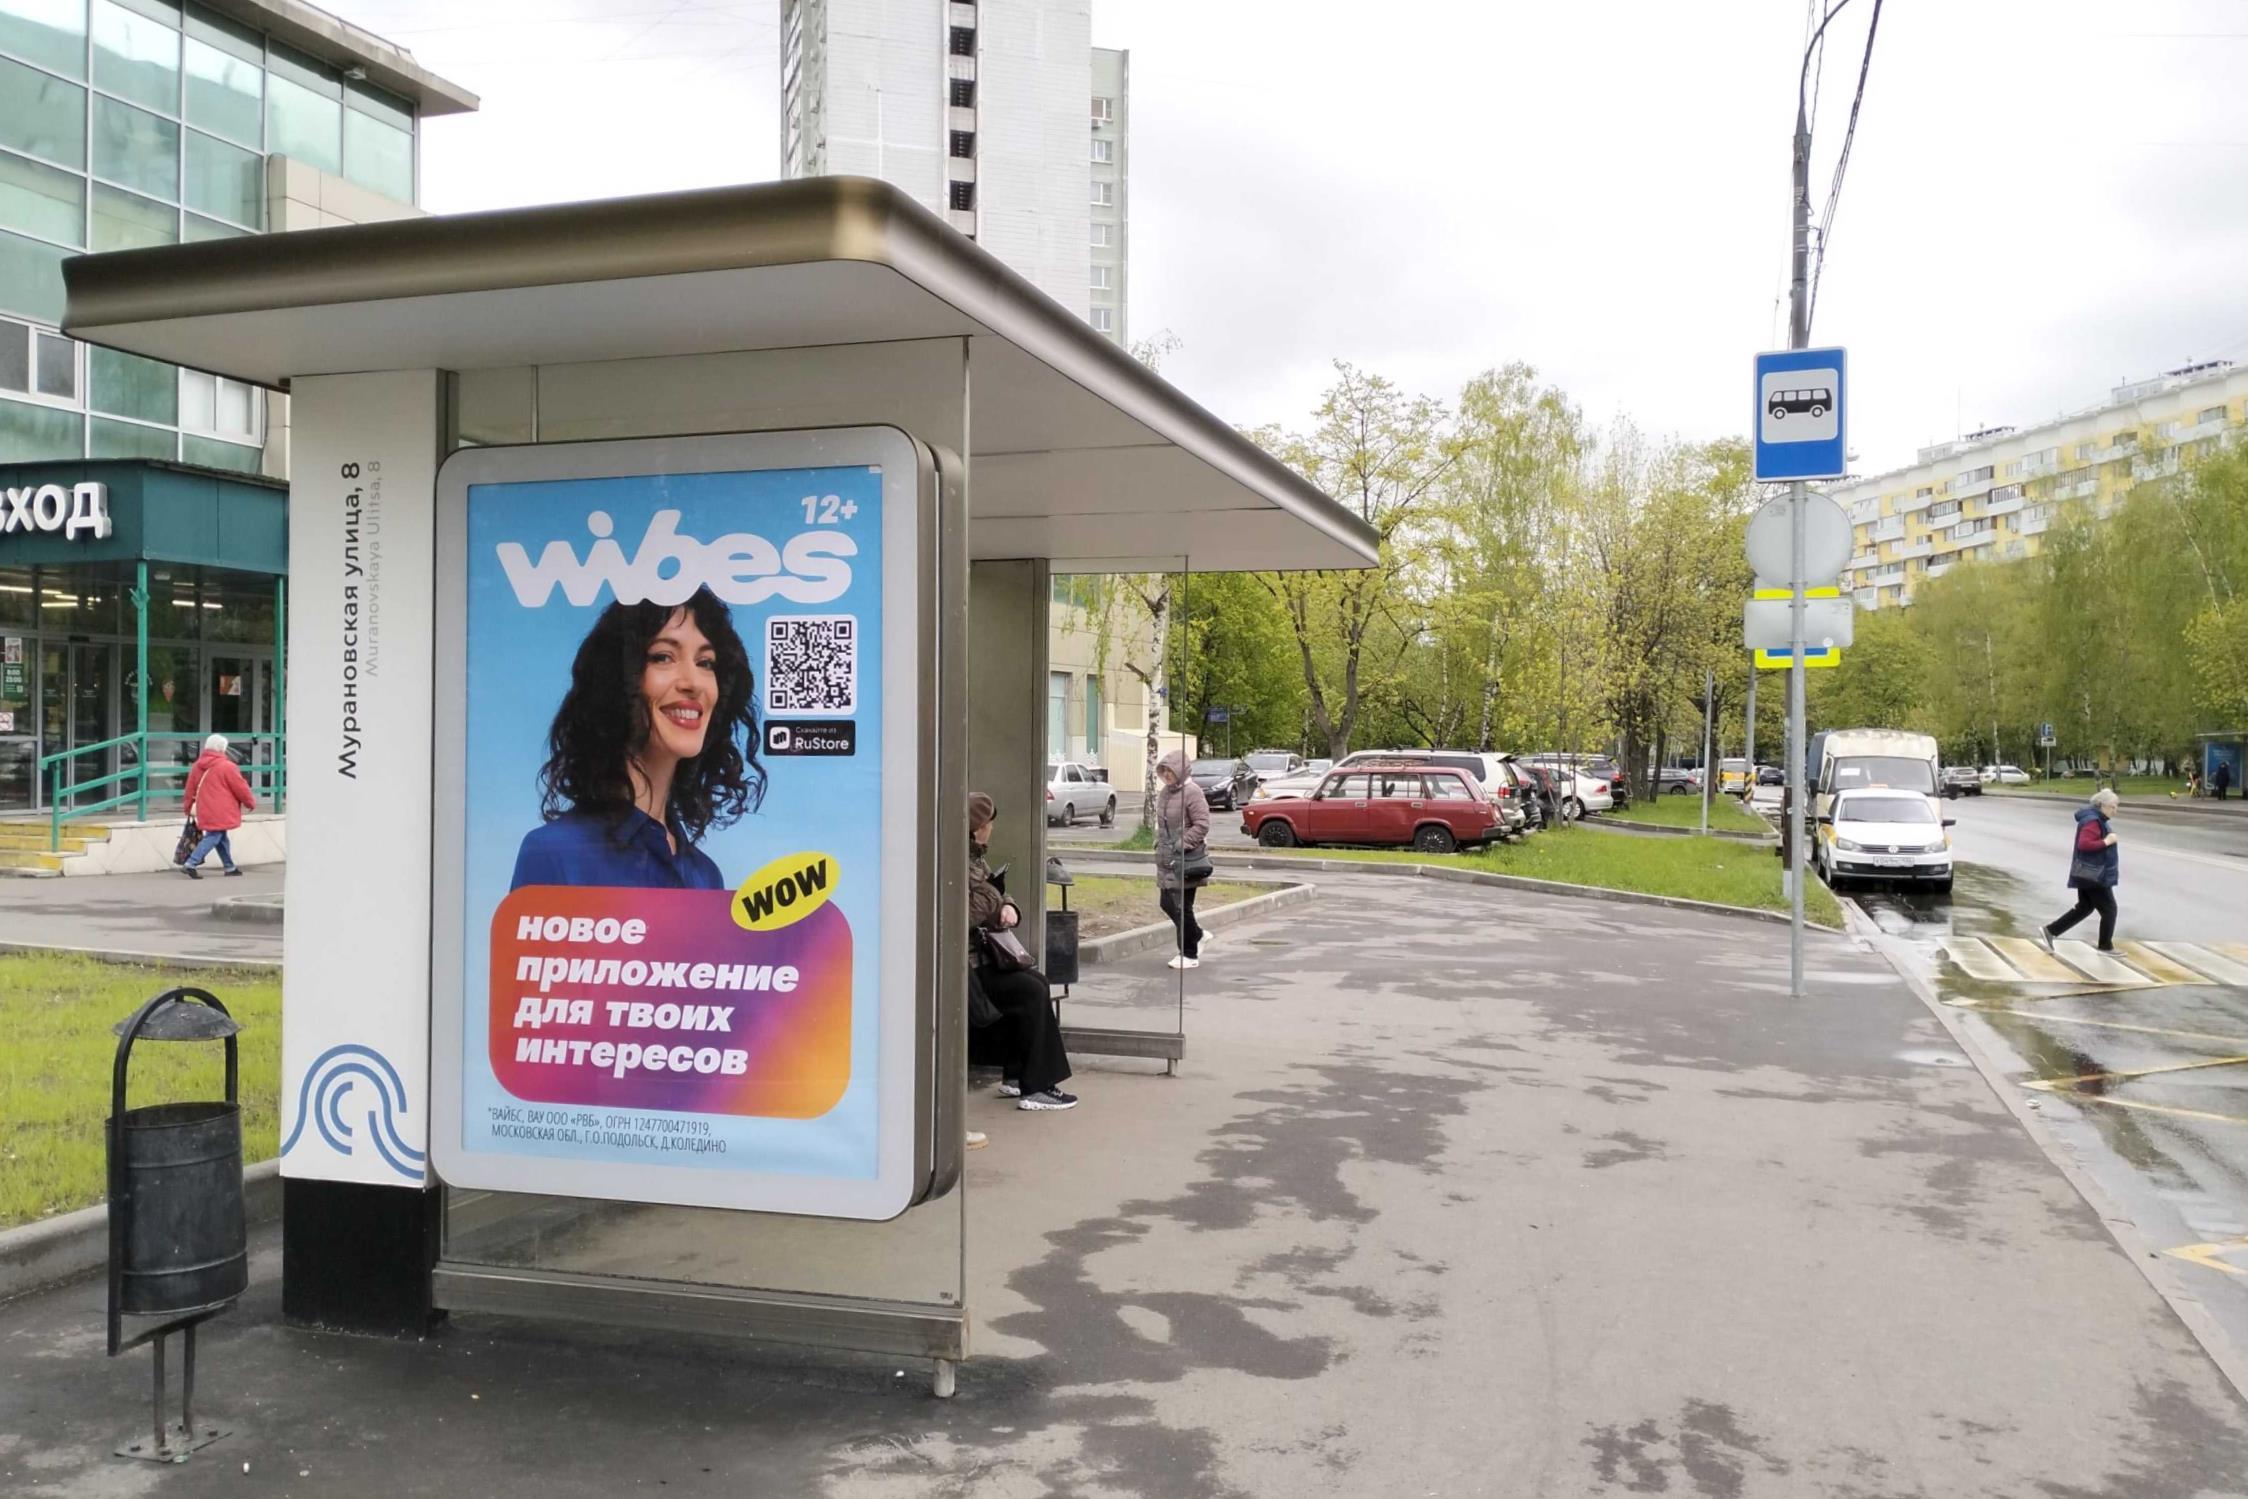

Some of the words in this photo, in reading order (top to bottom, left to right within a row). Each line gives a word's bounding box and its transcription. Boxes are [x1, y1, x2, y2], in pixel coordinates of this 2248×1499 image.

[341, 462, 360, 479] 8
[367, 460, 381, 472] 8
[0, 482, 107, 540] ХОД
[366, 477, 383, 536] Ulitsa,
[801, 495, 858, 525] 12+
[343, 487, 363, 577] улица,
[495, 508, 859, 608] wibes
[365, 541, 383, 677] Muranovskaya
[338, 585, 362, 780] Мурановская
[795, 737, 849, 750] RuStore
[741, 859, 828, 923] WOW
[516, 915, 647, 945] новое
[515, 956, 800, 993] приложение
[513, 997, 594, 1029] для
[605, 1001, 735, 1033] твоих
[515, 1037, 748, 1079] интересов
[491, 1124, 555, 1141] МОСКОВСКАЯ
[661, 1136, 727, 1154] Д.КОЛЕДИНО
[527, 1109, 545, 1123] ВАУ
[546, 1111, 569, 1126] ООО
[605, 1115, 632, 1130] ОГРН
[633, 1117, 712, 1137] 1247700471919,
